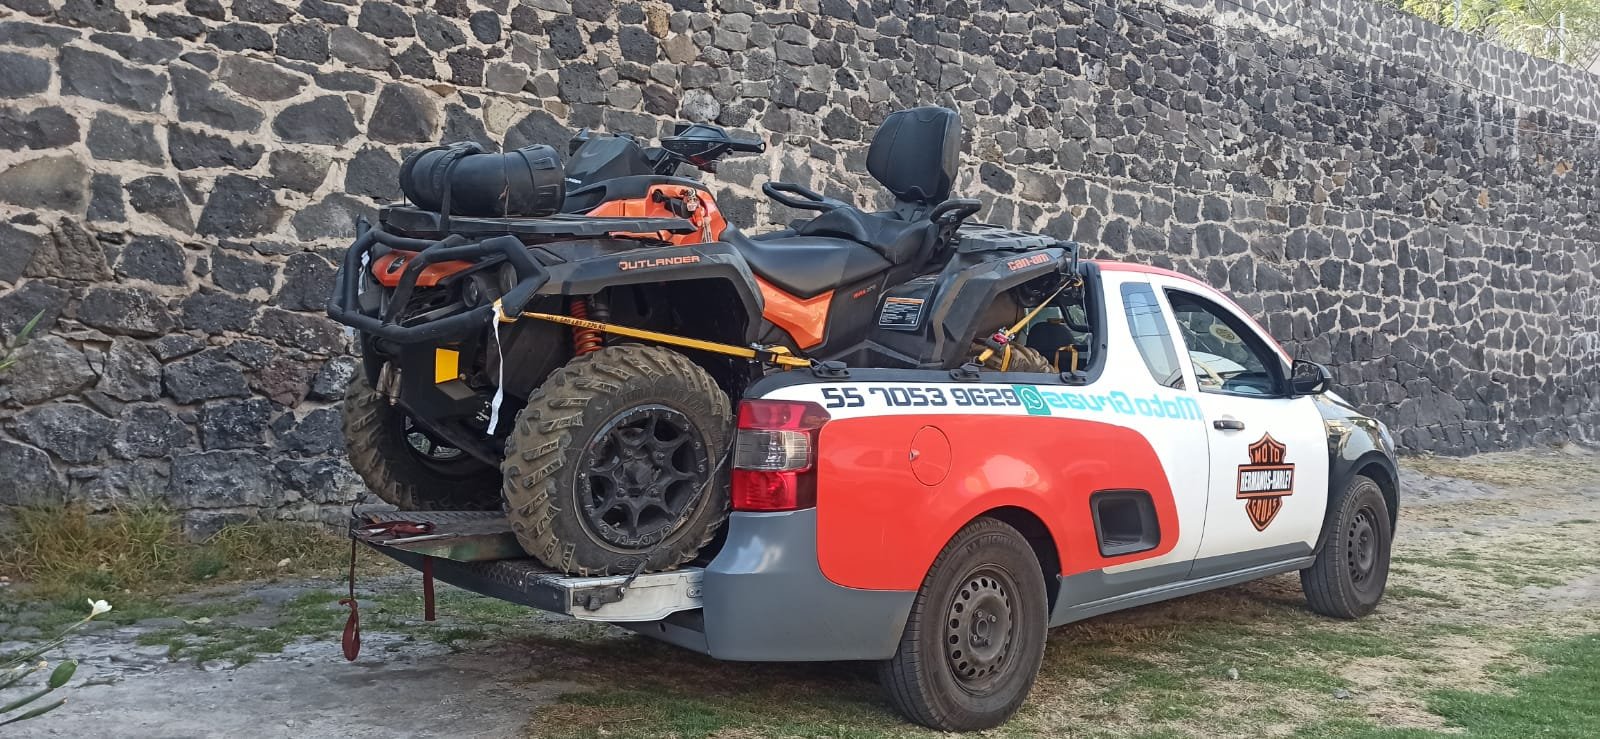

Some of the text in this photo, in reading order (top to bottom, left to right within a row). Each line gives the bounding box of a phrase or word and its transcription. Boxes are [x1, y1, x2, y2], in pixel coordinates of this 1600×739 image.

[618, 255, 700, 271] OUTLANDER
[820, 387, 1022, 408] 55 7053 9629
[1254, 443, 1280, 463] MOTO
